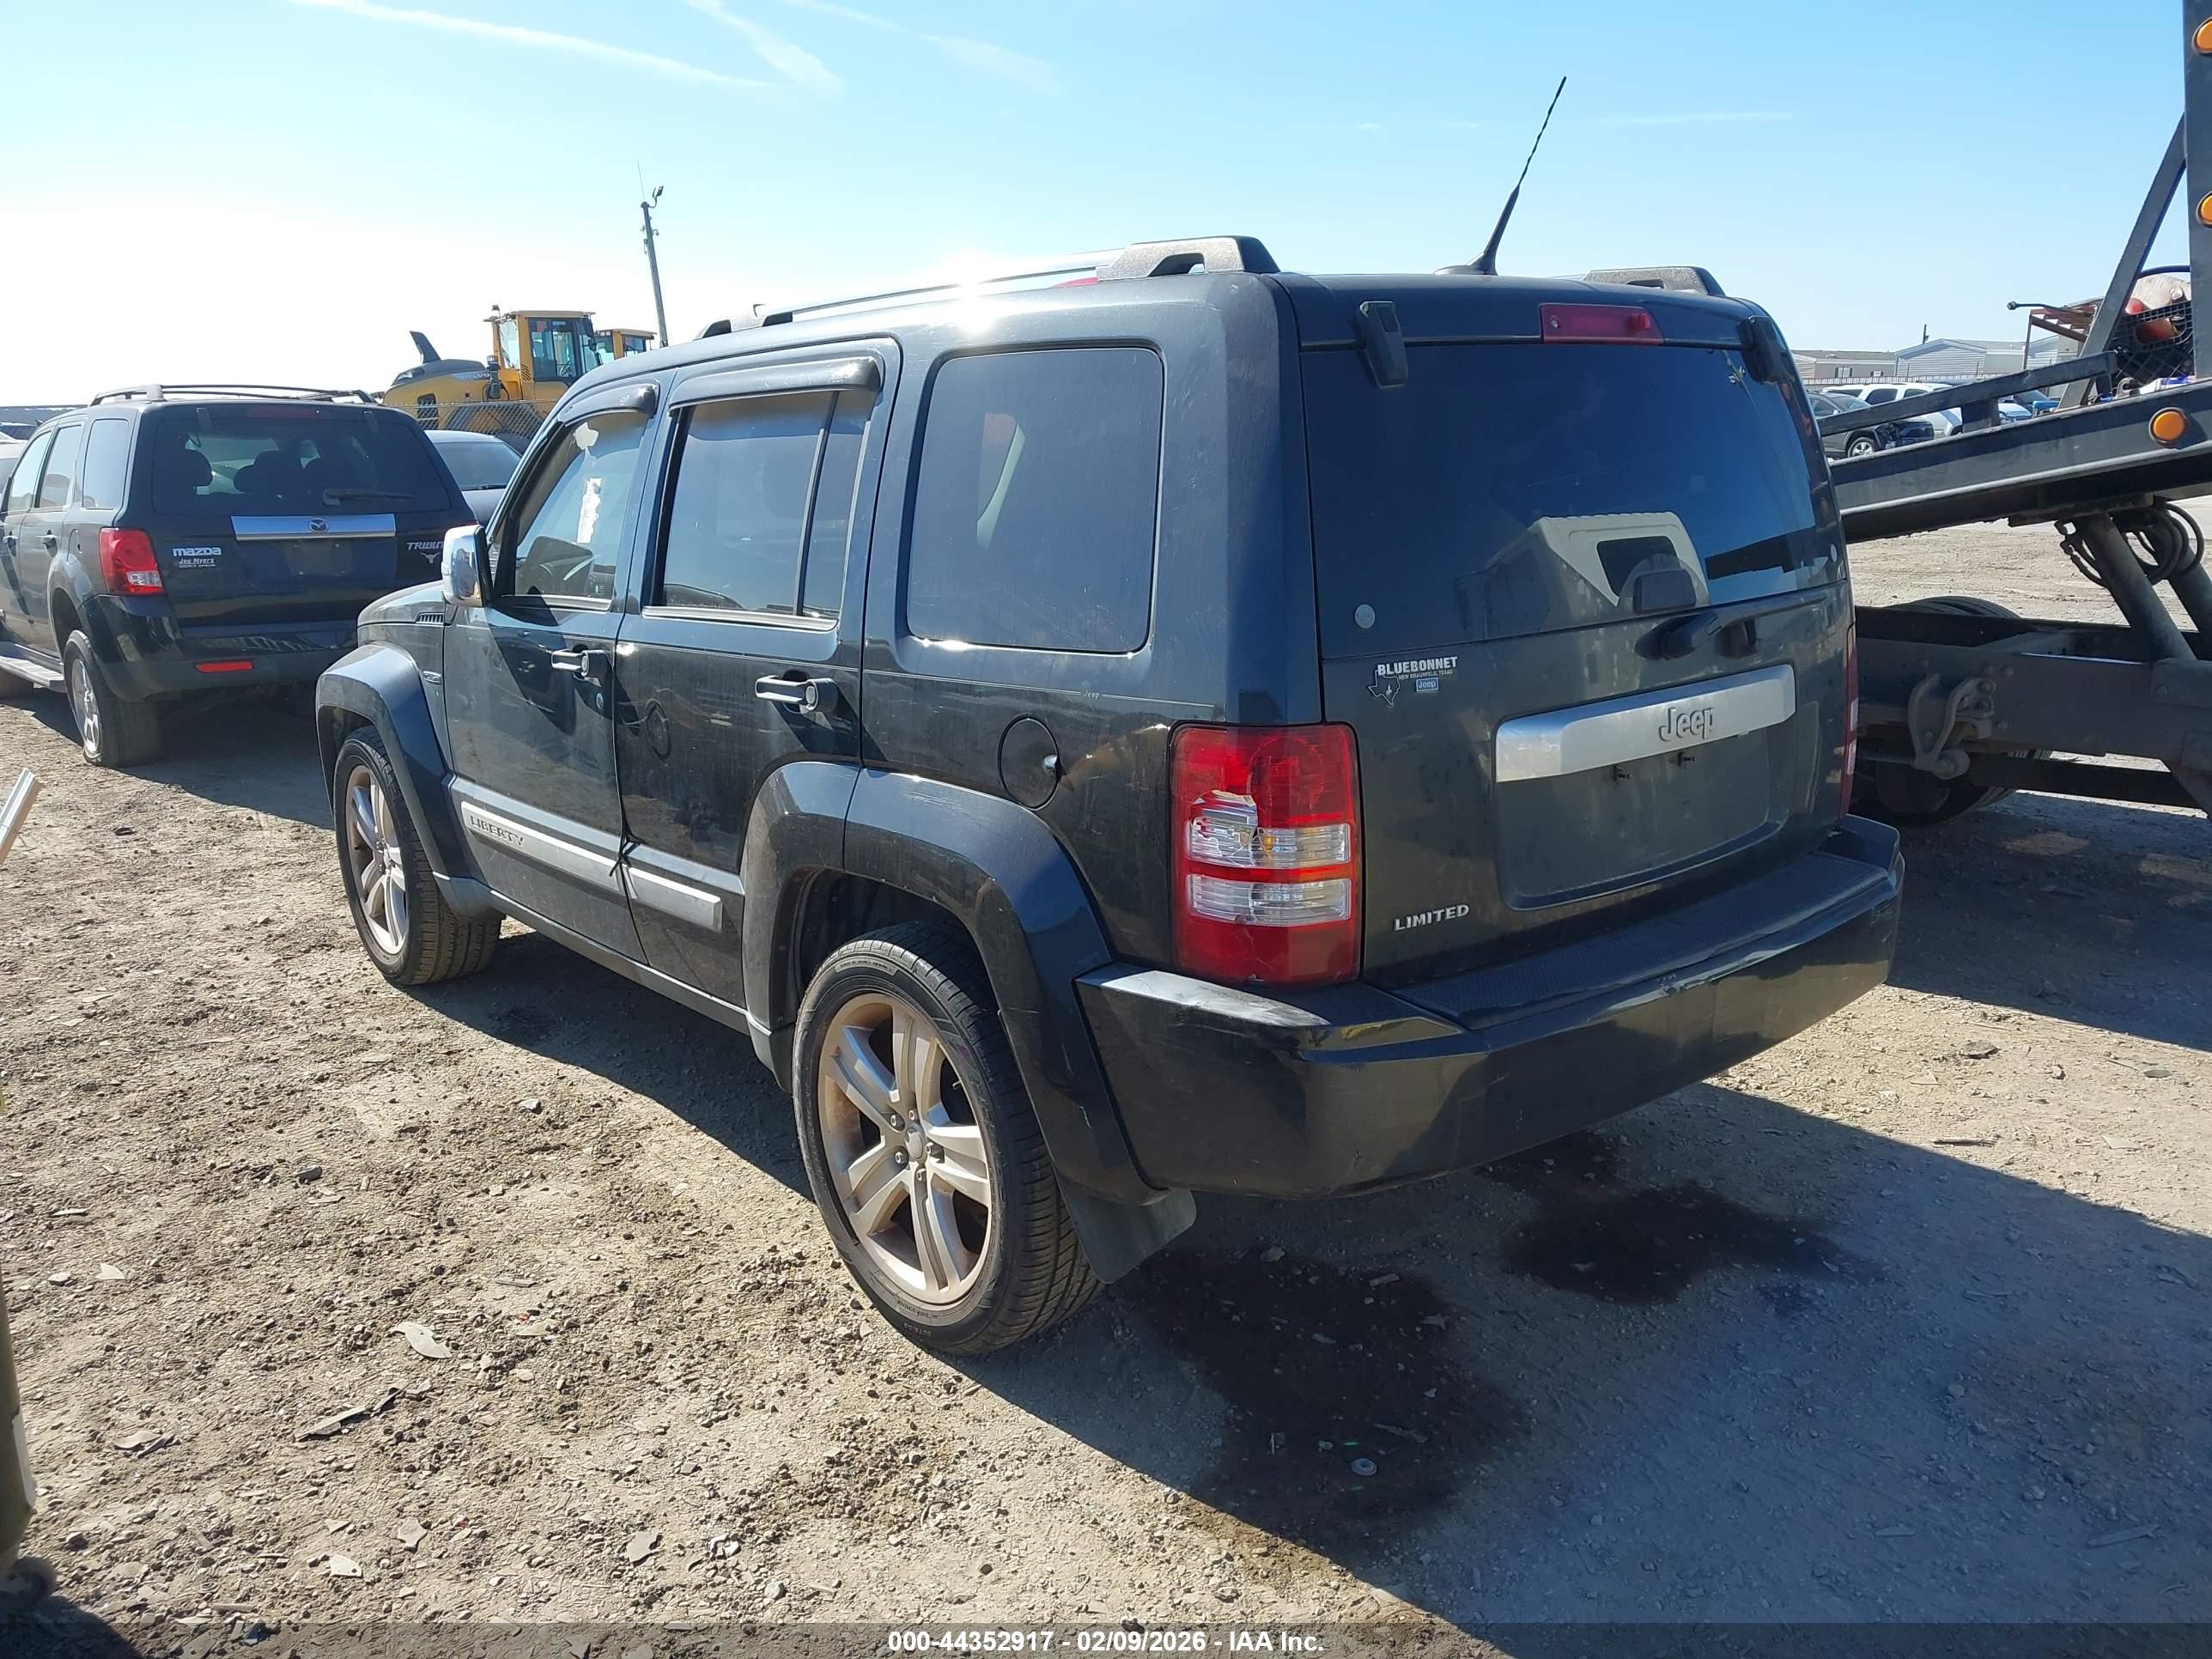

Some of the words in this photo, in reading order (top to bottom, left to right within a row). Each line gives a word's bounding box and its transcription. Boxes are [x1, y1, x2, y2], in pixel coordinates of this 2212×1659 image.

[172, 547, 222, 557] mazda
[407, 541, 445, 550] TRIBUT
[1376, 656, 1458, 676] BLUEBONNET
[1418, 679, 1437, 689] Jeep
[1658, 707, 1716, 742] Jeep
[469, 815, 525, 847] LIBERTY
[1394, 903, 1470, 932] LIMITED
